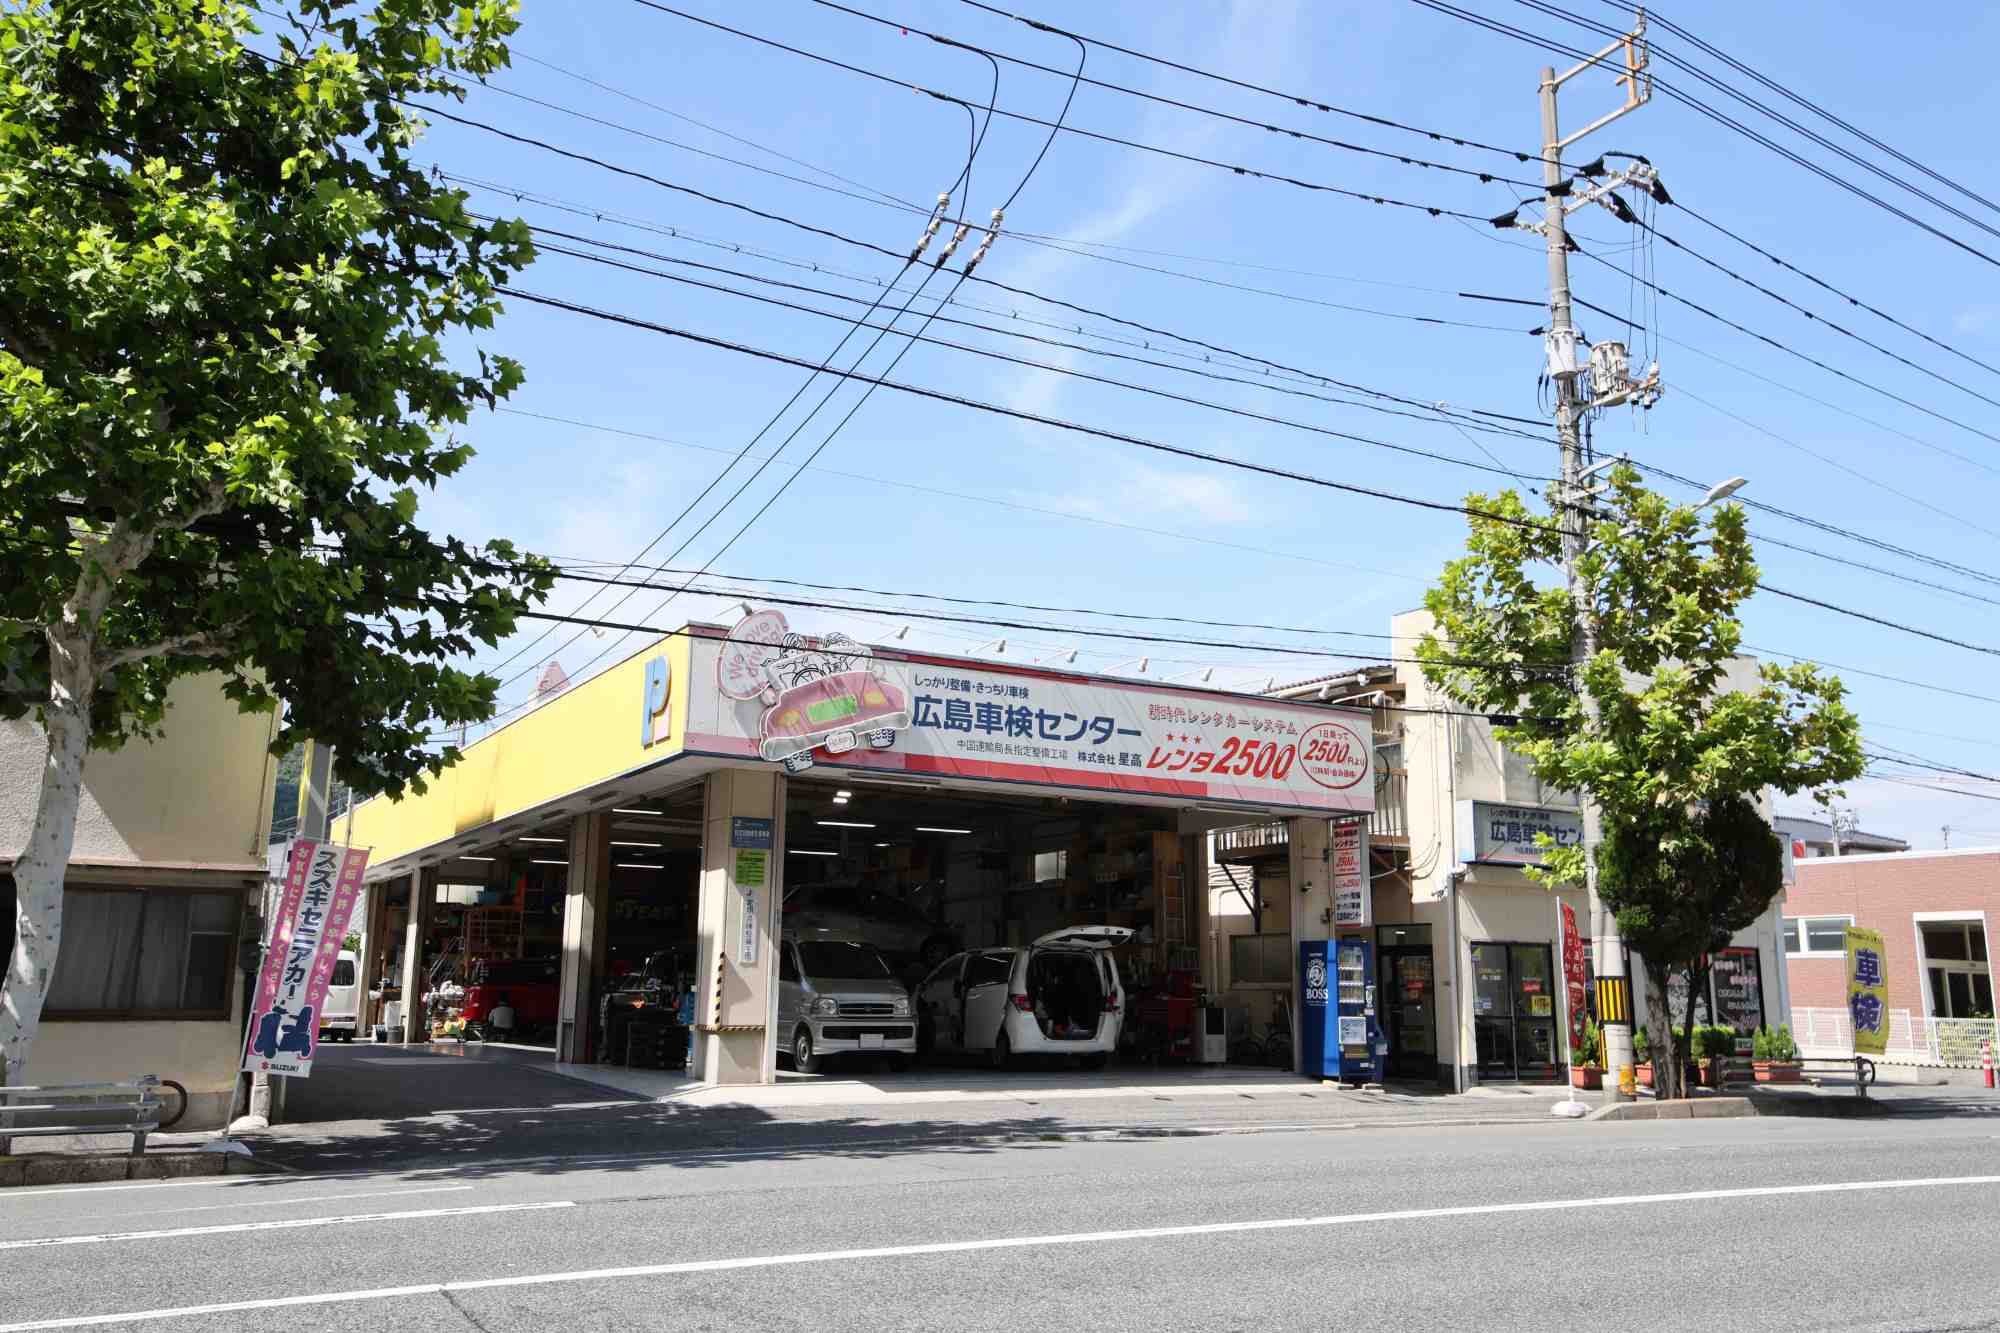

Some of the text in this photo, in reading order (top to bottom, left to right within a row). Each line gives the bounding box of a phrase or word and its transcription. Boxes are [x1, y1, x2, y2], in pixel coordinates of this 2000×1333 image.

[914, 672, 1030, 699] しっかり整備・きっちり車検
[911, 694, 1142, 744] 広島車検センター
[1146, 736, 1296, 780] レンタ2500
[1306, 988, 1328, 1000] BOSS
[1851, 947, 1884, 1036] 車検
[271, 1064, 299, 1072] SUZUKI
